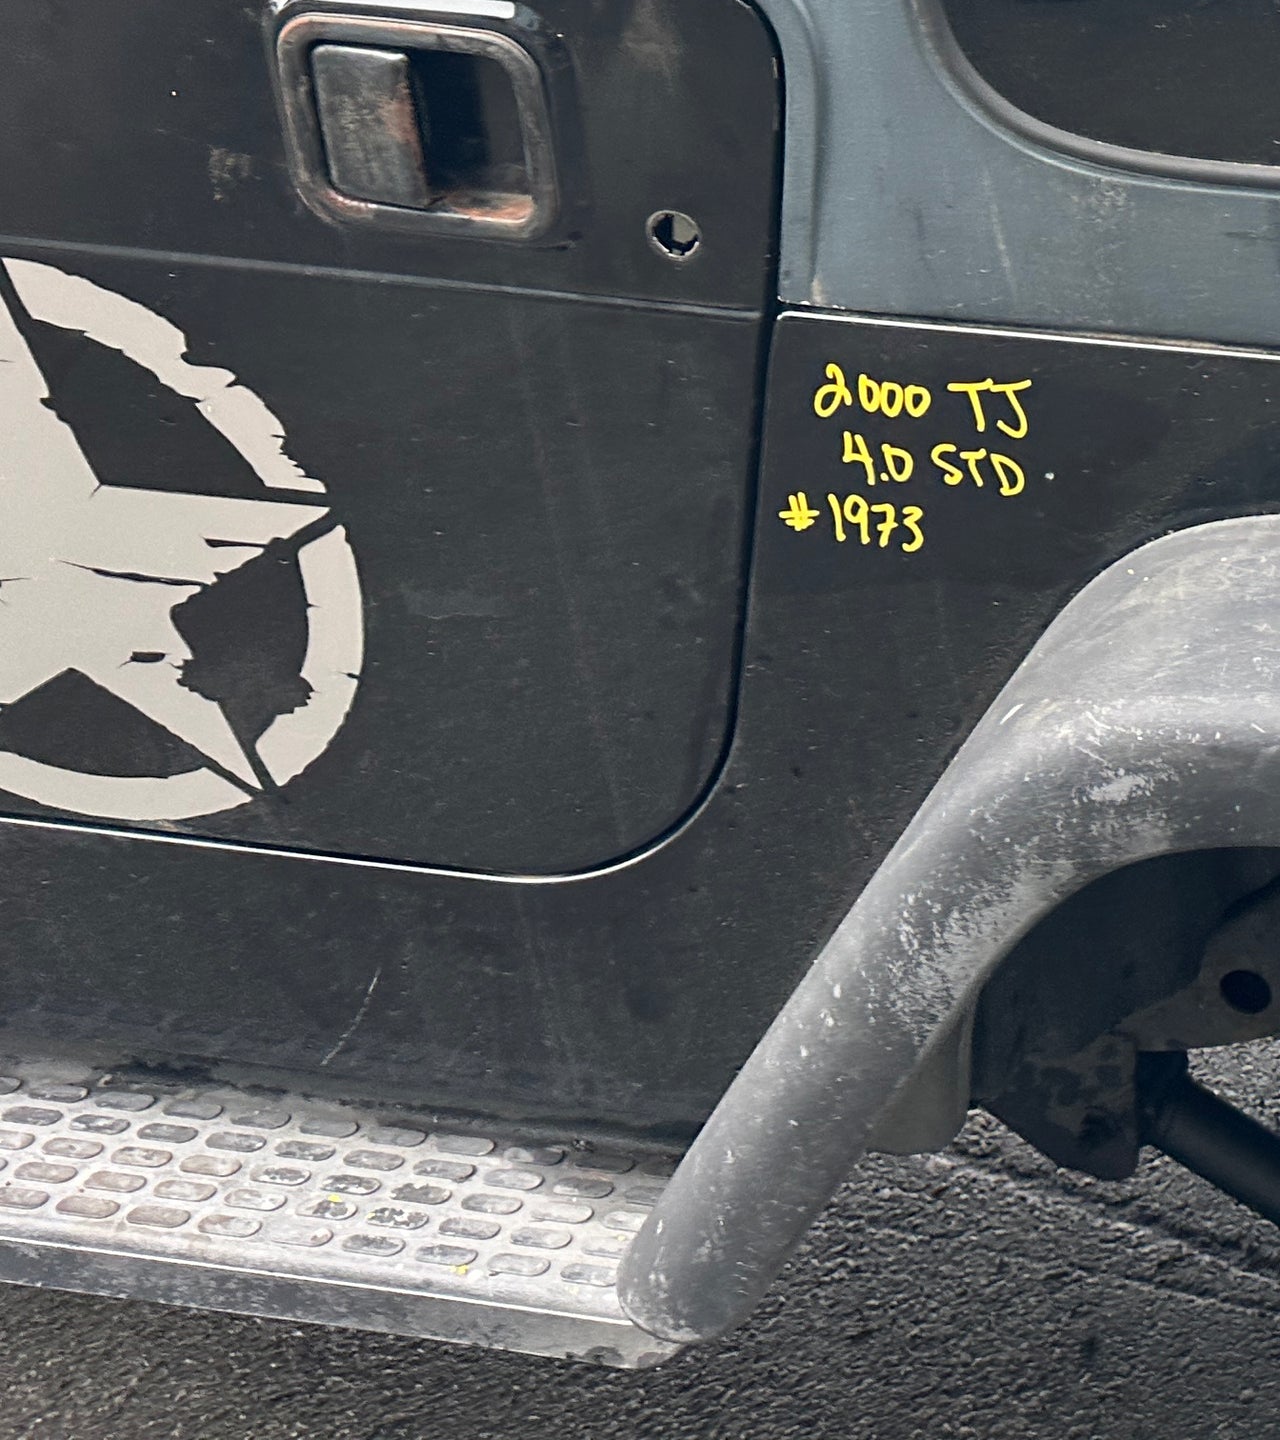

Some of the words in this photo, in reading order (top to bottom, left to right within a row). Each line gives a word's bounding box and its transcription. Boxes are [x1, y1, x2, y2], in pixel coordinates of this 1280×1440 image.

[813, 362, 932, 419] 2000
[946, 377, 1032, 439] TJ
[841, 430, 915, 487] 4.0
[929, 442, 1026, 497] STD
[777, 491, 925, 553] #1973
